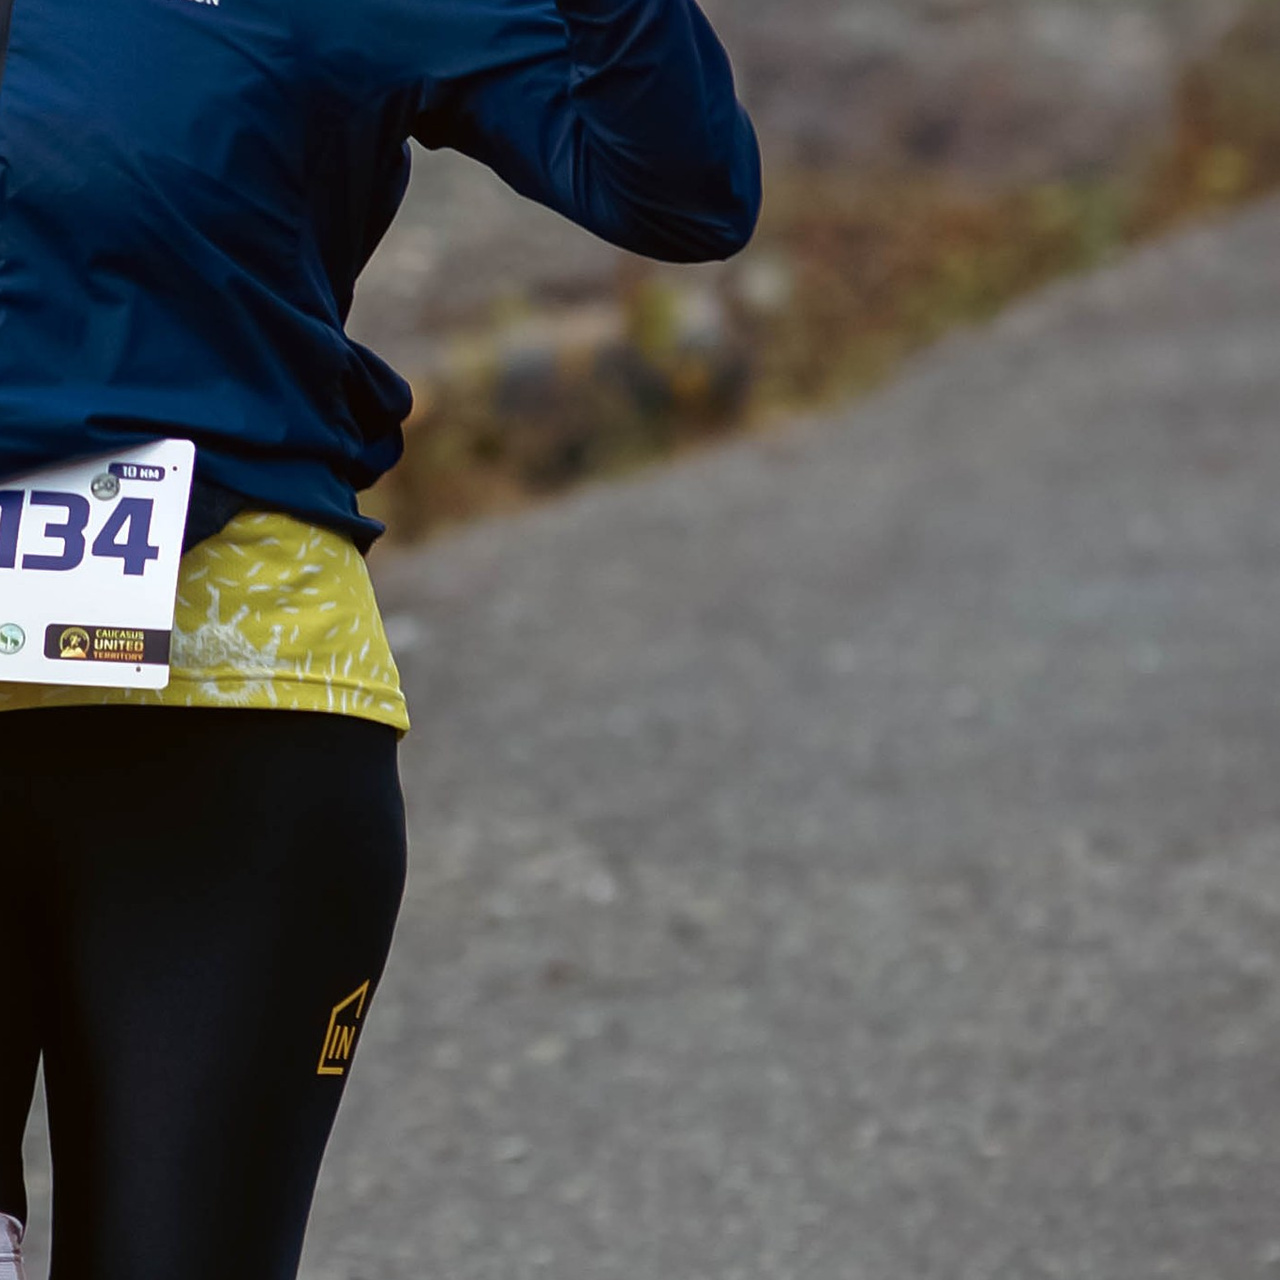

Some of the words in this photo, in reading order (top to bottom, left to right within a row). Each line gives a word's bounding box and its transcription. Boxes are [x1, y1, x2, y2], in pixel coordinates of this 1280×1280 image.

[123, 466, 137, 478] 10
[95, 629, 144, 639] CAUCASUS
[94, 639, 144, 652] UNITED
[93, 650, 144, 661] TERRITORY
